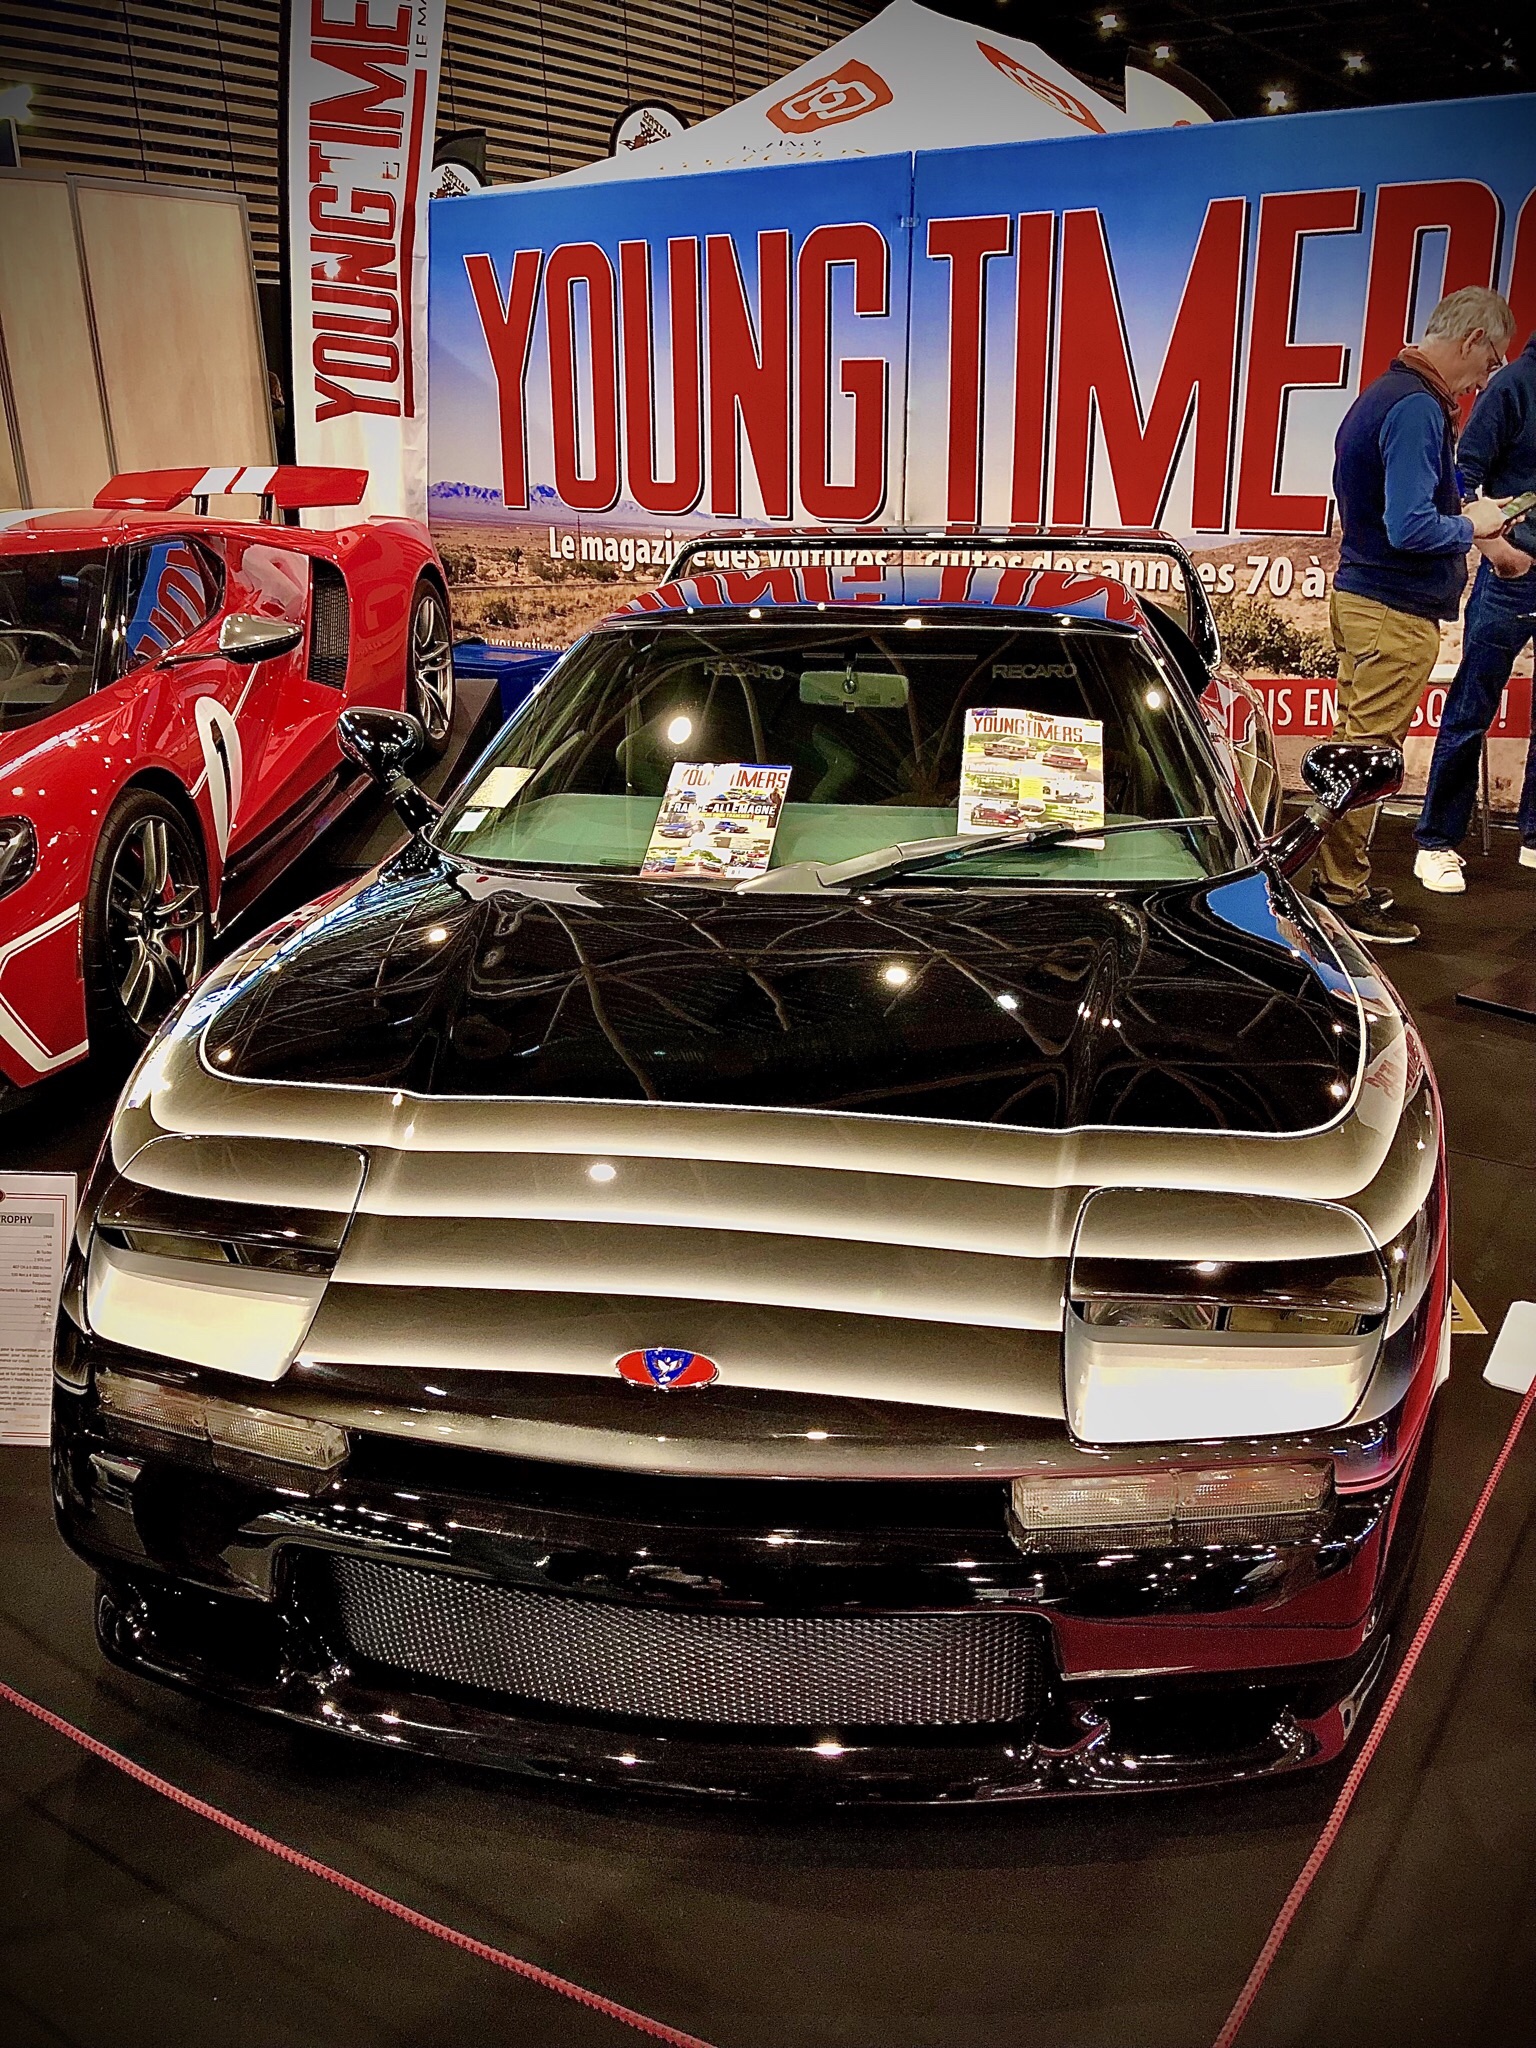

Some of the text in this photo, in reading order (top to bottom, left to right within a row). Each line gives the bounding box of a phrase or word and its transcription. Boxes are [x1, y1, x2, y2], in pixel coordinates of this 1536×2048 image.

[463, 178, 1536, 536] YOUNG TIMER
[549, 527, 575, 560] Le
[1246, 556, 1293, 597] 70
[1302, 553, 1326, 598] à
[704, 661, 785, 681] RECARO
[992, 663, 1078, 679] RECARO
[973, 716, 1083, 743] YOUNGTIMERS
[668, 800, 777, 815] FRANE-ALLEMAGNE
